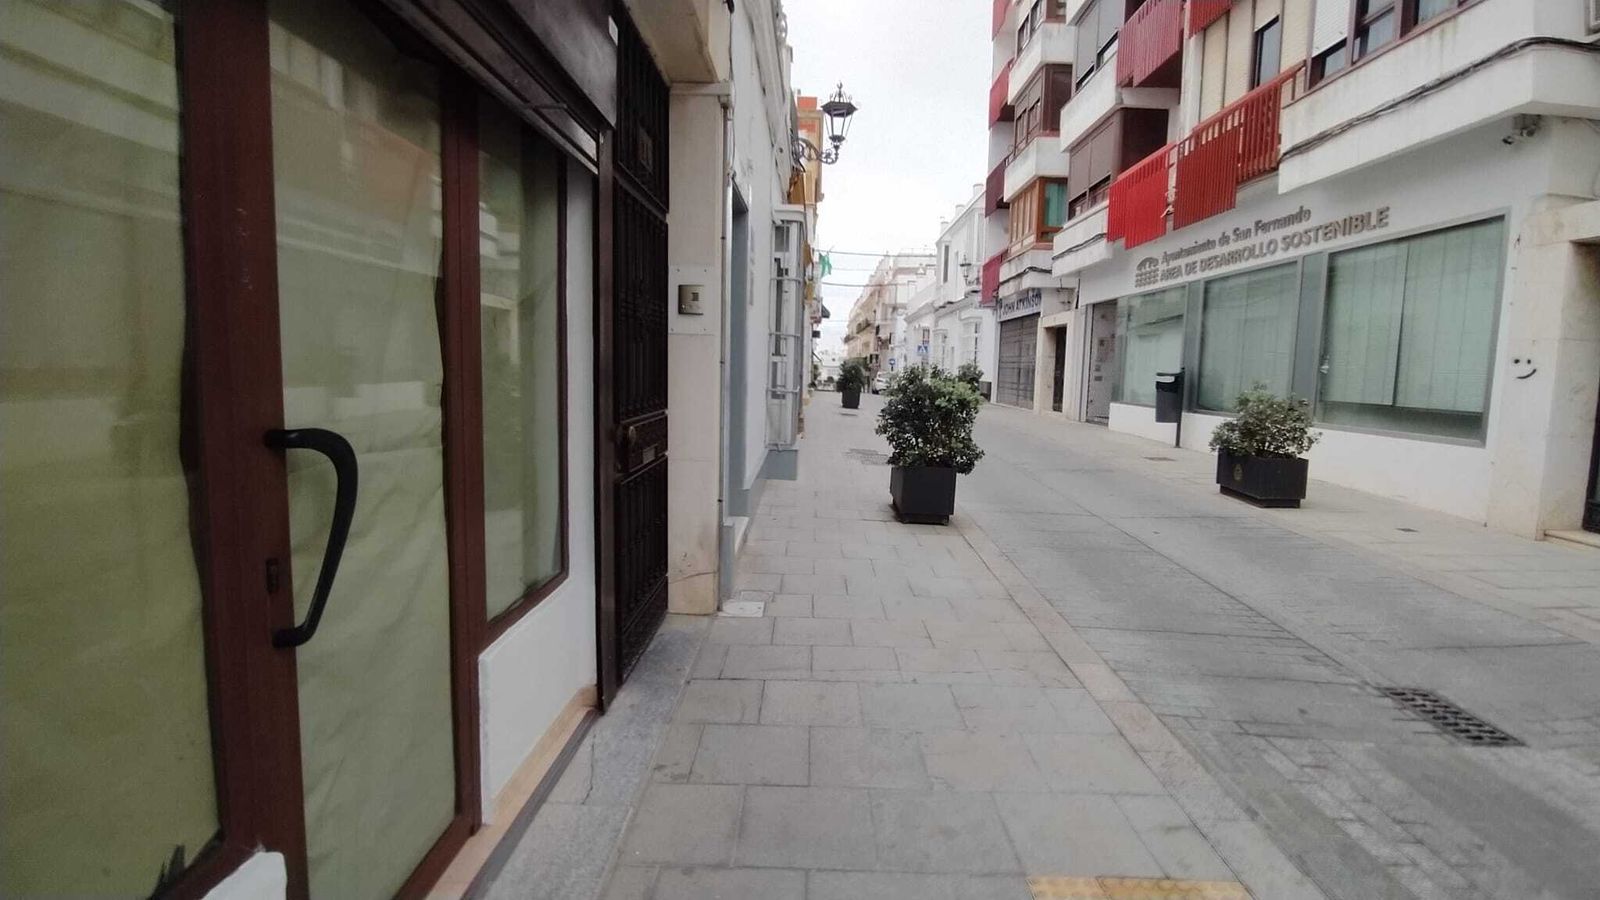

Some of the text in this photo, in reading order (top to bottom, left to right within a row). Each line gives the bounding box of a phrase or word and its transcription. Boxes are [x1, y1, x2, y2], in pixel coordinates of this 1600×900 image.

[1161, 205, 1312, 267] Ayuntamiento de San Fernando
[1184, 260, 1199, 276] DE
[1199, 238, 1279, 272] DESARROLLO
[1281, 206, 1390, 254] SOSTENIBLE
